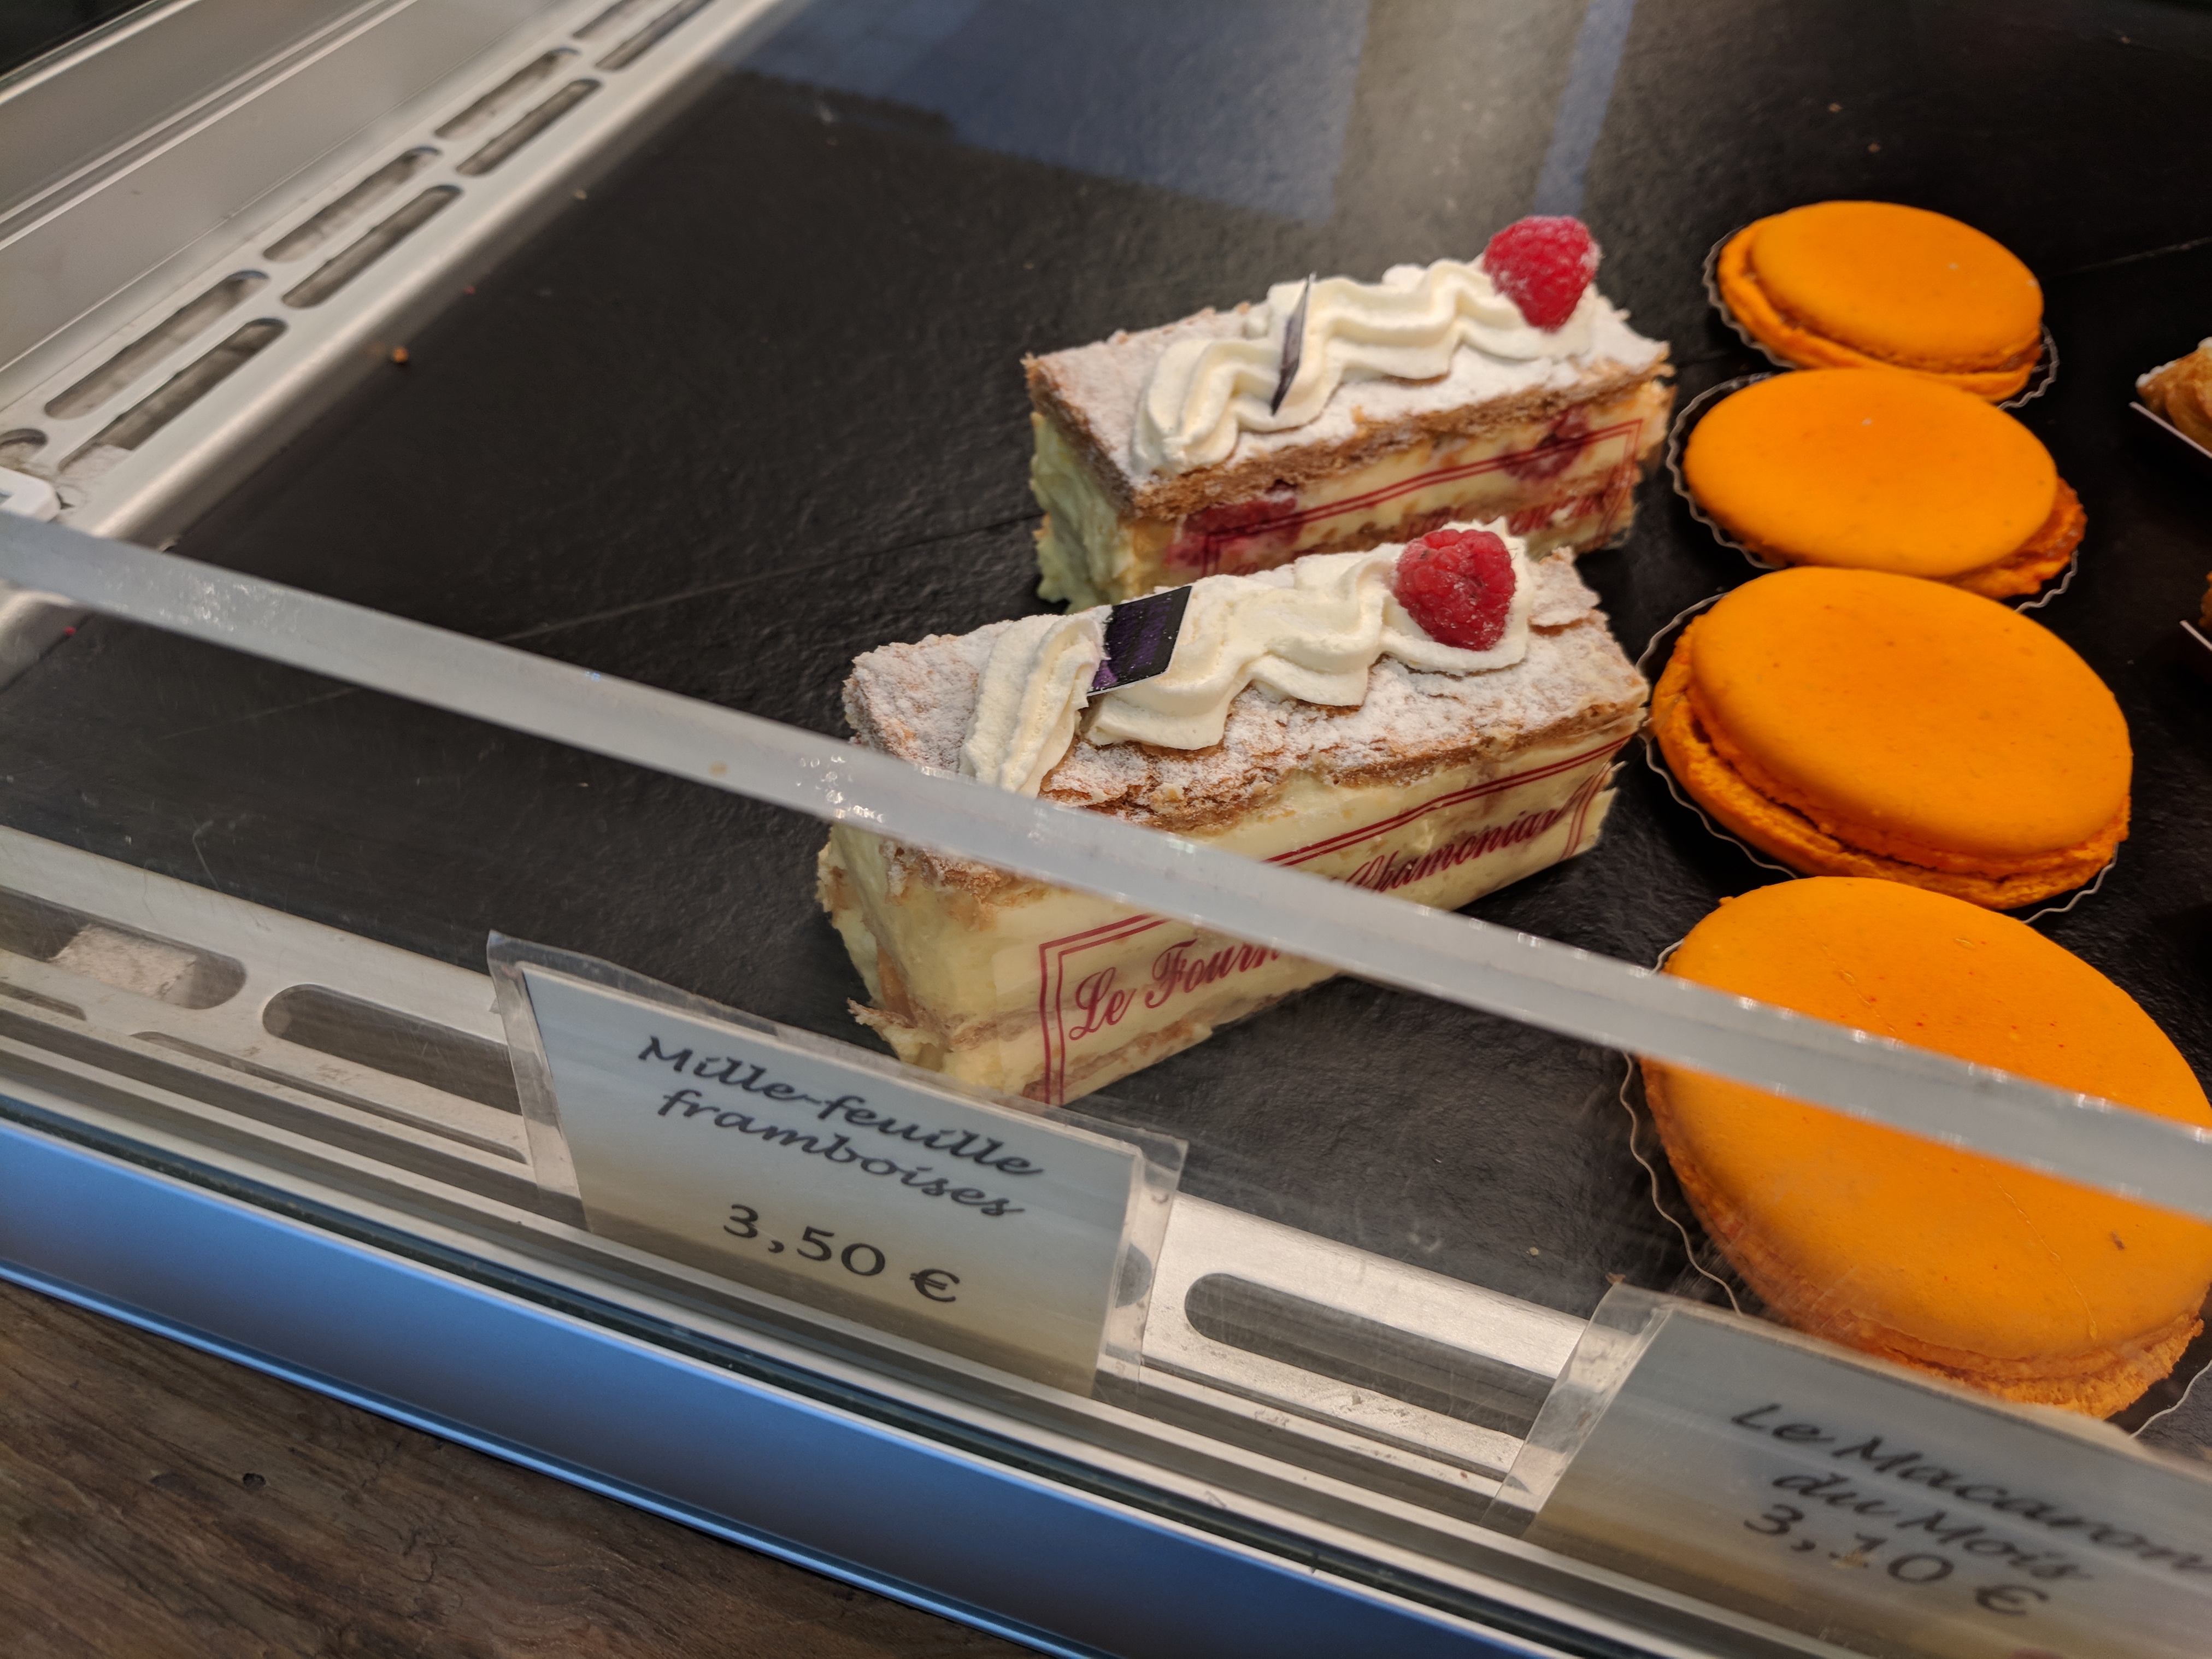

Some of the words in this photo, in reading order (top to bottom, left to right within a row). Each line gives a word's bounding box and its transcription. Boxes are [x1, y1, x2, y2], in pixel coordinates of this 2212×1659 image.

[1069, 966, 1137, 1040] Le
[638, 1036, 1044, 1175] Mille-feuille
[658, 1089, 1026, 1216] framboises
[723, 1204, 885, 1276] 3,50
[909, 1268, 960, 1303] €
[1731, 1403, 1836, 1444] Le
[1831, 1435, 2212, 1575] Macaron
[1772, 1473, 1901, 1516] du
[1895, 1510, 2096, 1580] Mois
[1975, 1585, 2050, 1616] €
